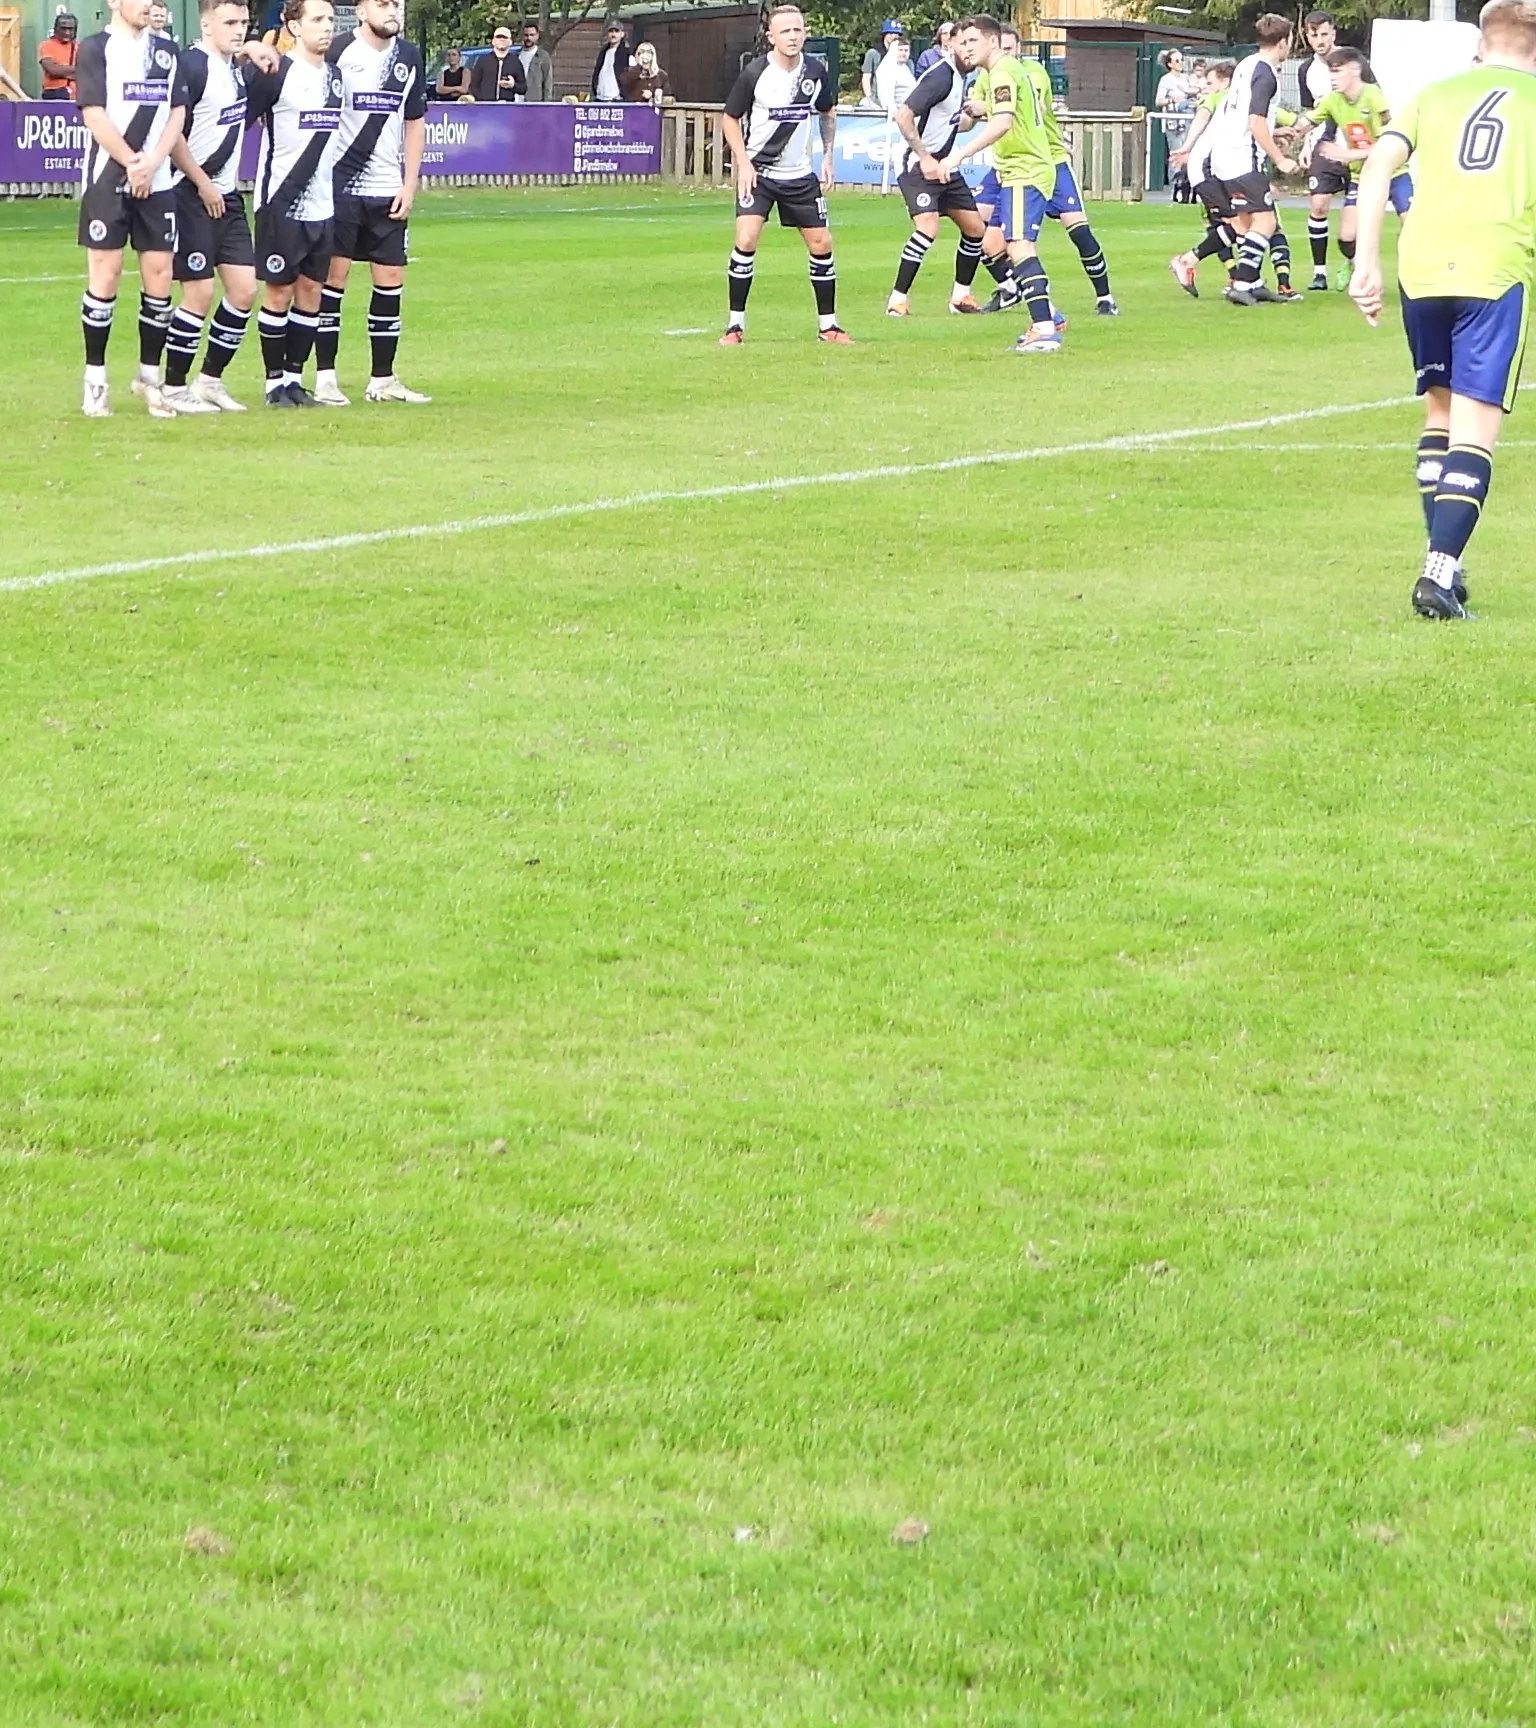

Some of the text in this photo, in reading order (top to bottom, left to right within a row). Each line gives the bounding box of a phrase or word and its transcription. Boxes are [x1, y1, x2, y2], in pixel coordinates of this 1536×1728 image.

[17, 115, 92, 150] JP&Brim
[1457, 88, 1509, 172] 6
[44, 158, 68, 169] ESTATE
